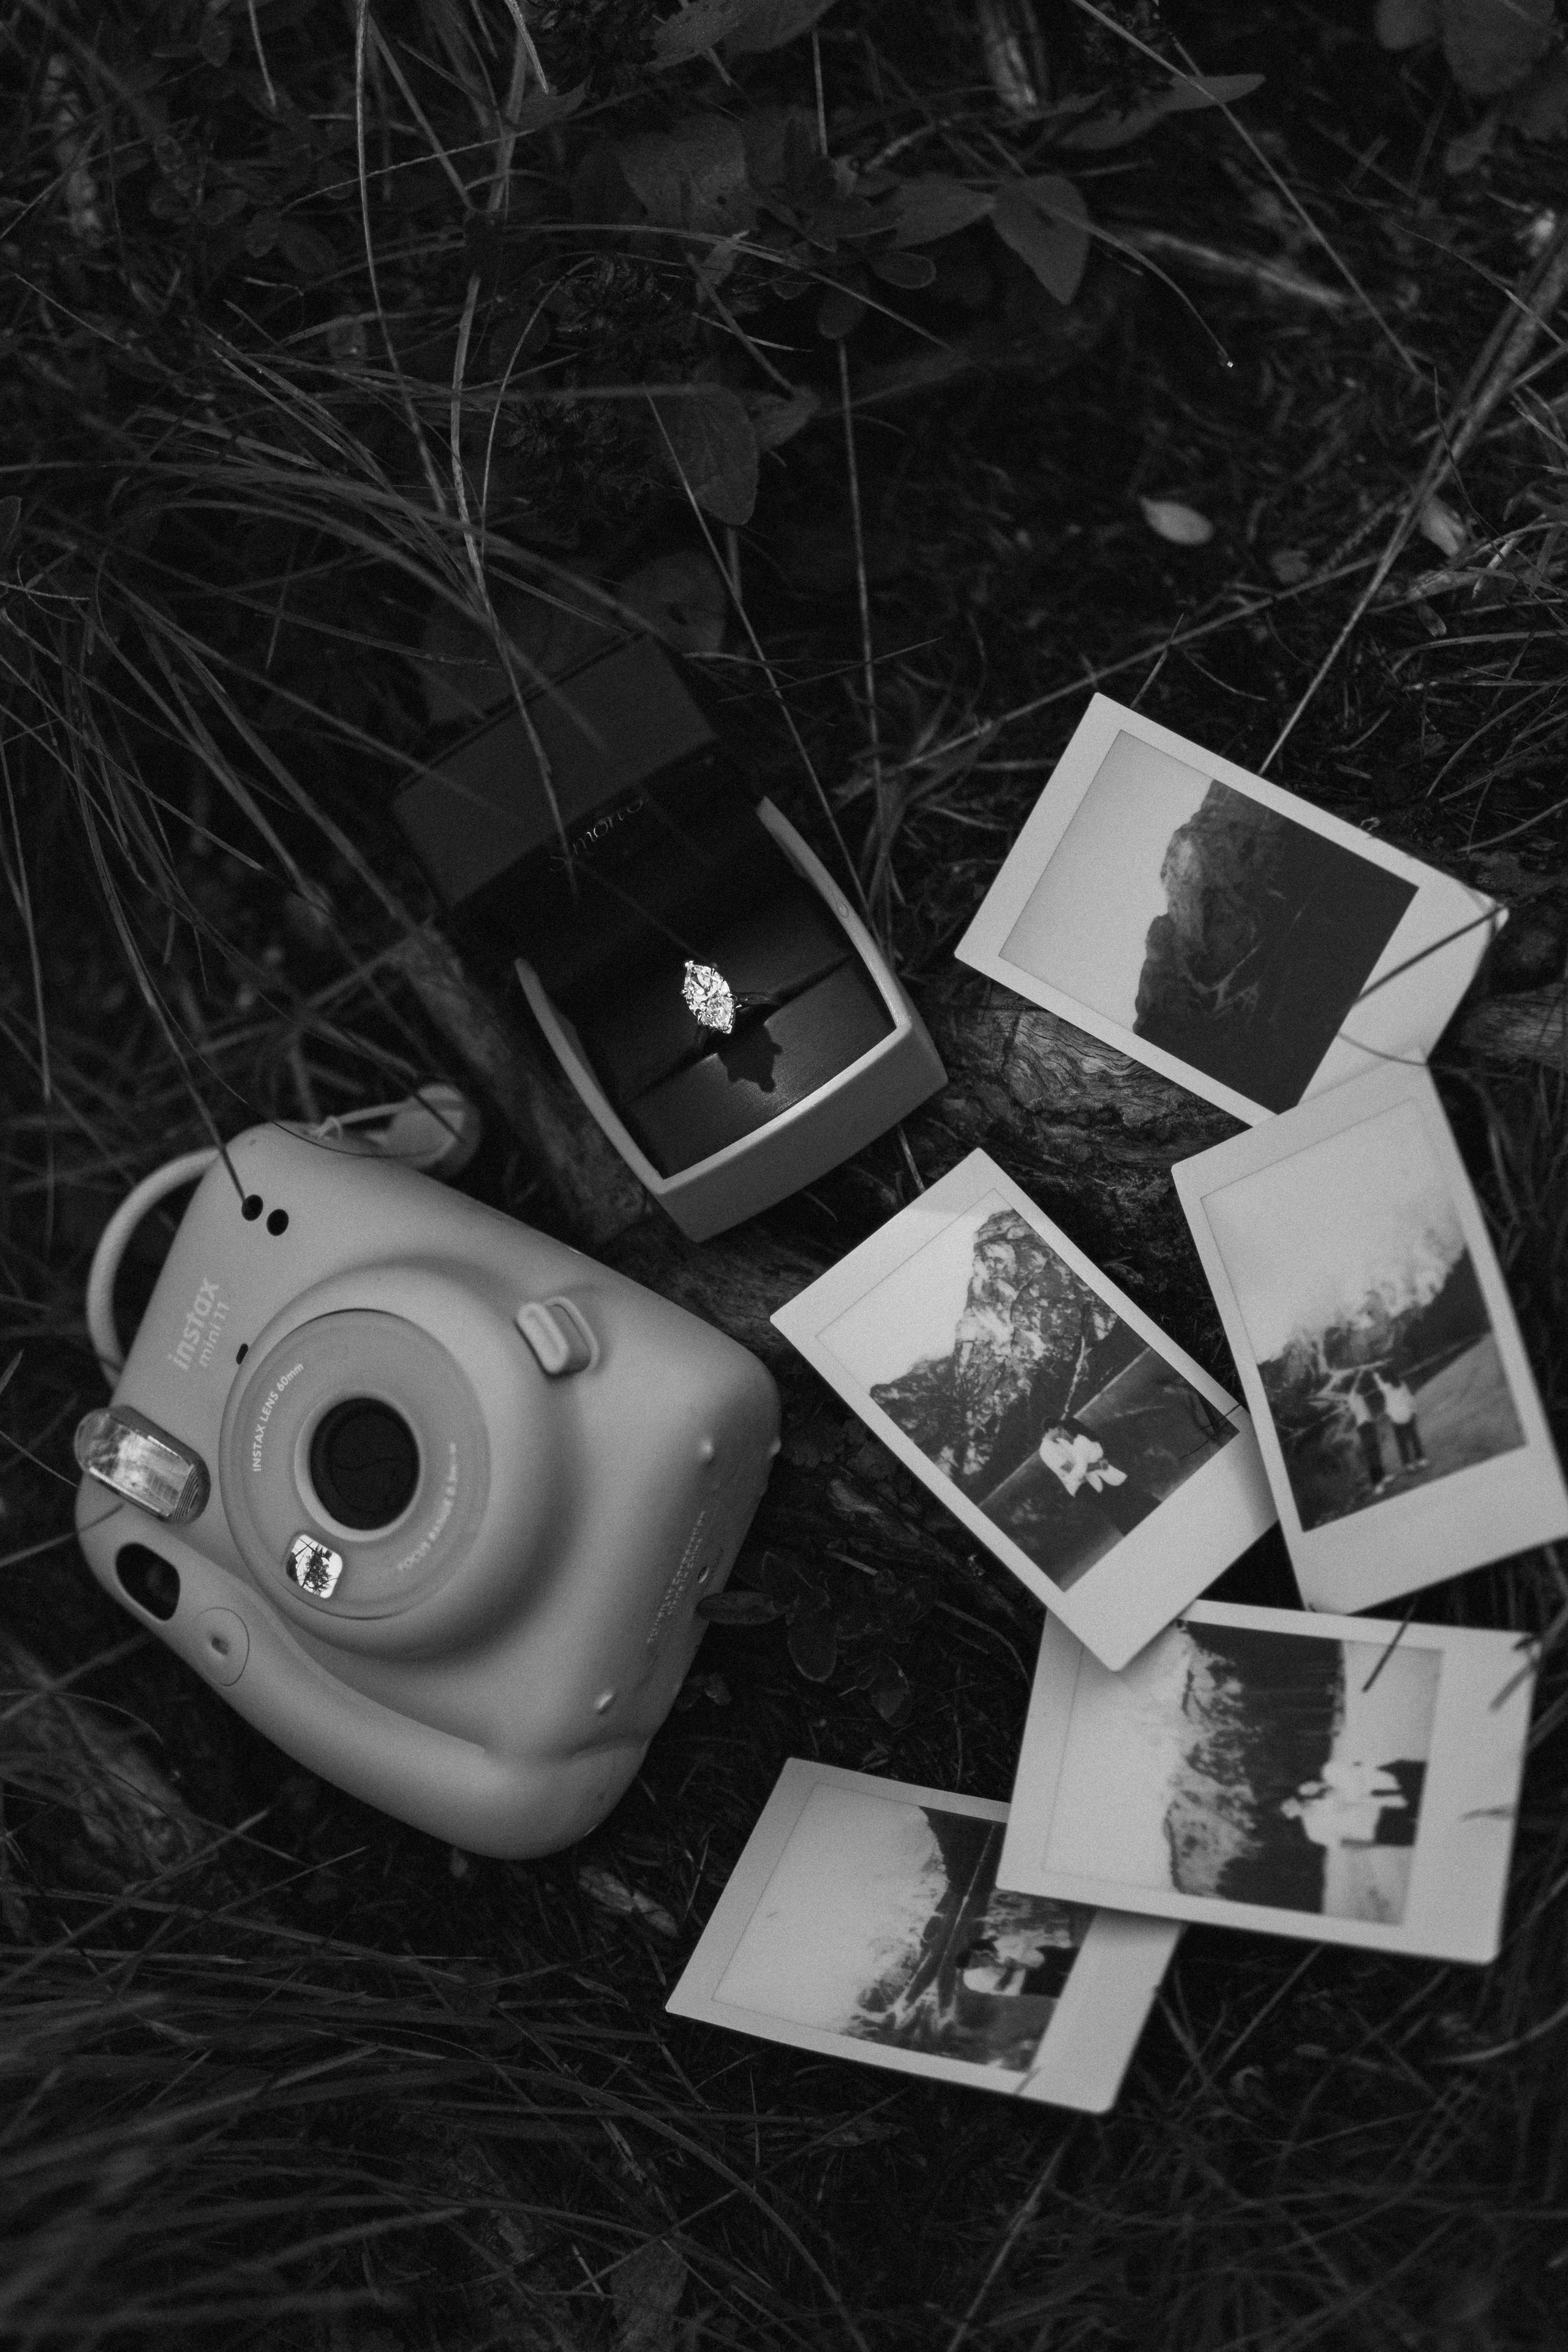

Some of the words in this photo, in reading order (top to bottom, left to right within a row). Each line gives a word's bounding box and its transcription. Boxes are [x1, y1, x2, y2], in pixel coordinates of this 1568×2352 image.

[167, 1278, 219, 1370] instax
[199, 1322, 222, 1368] mini
[214, 1301, 229, 1321] 11
[252, 1423, 266, 1472] INSTAX
[260, 1390, 279, 1422] LENS
[277, 1363, 304, 1392] 60mm
